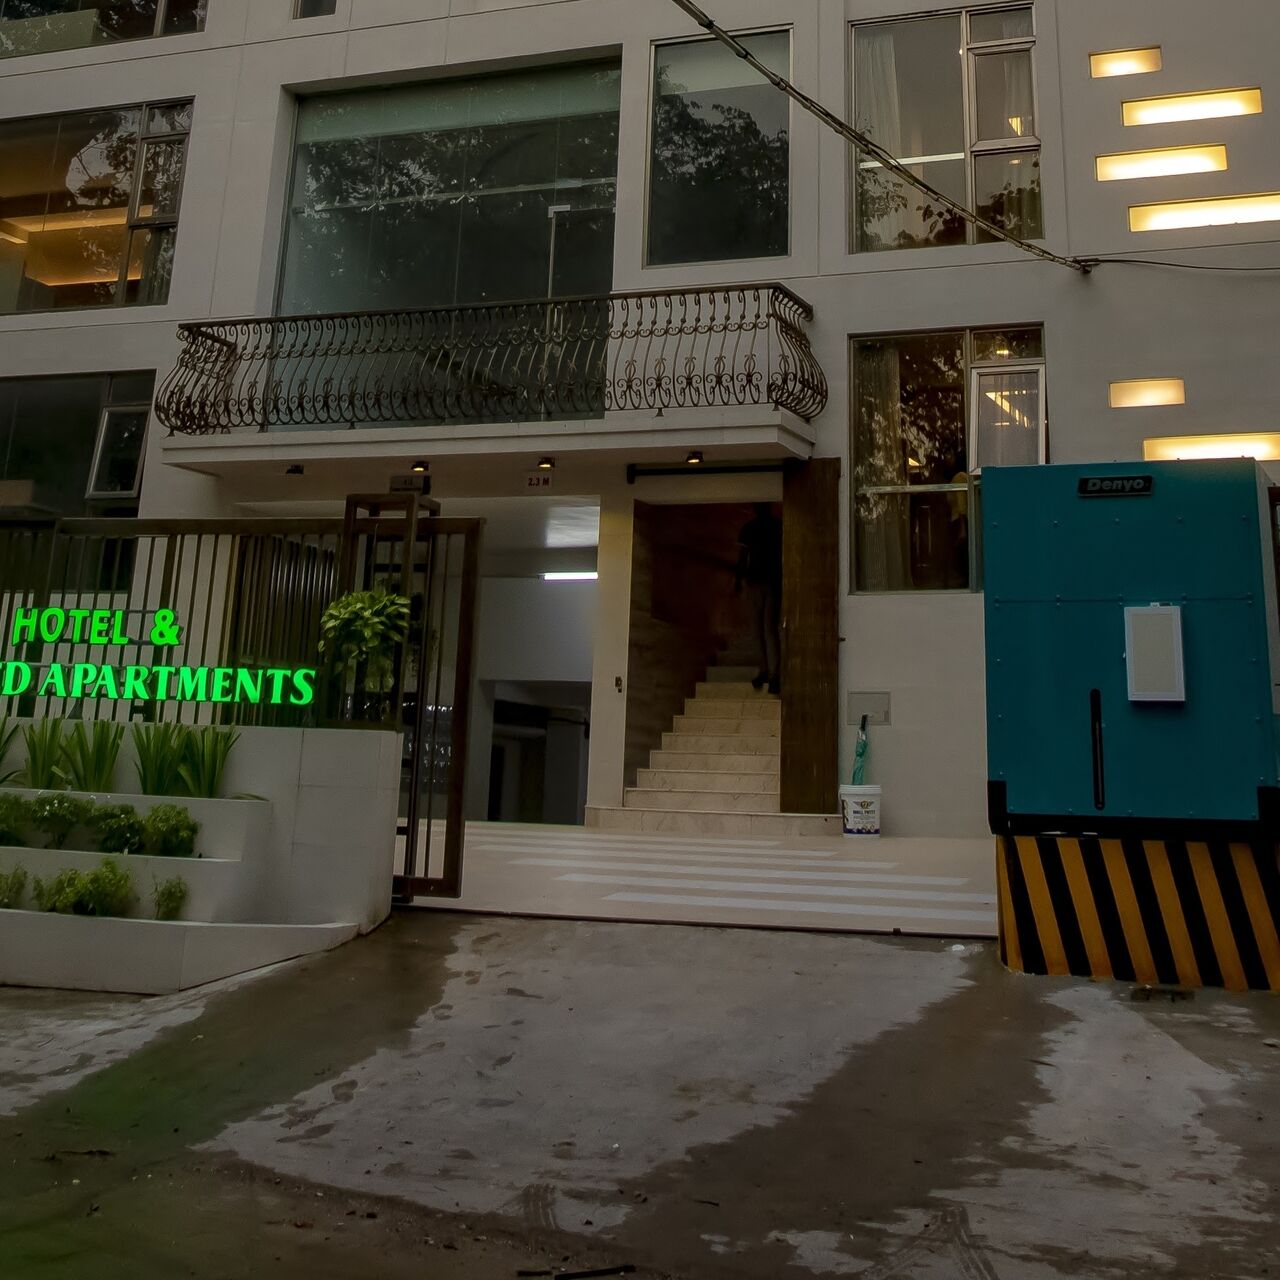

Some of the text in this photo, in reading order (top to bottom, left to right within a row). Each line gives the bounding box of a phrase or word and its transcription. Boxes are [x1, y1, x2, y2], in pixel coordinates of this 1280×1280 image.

[528, 477, 550, 487] 2.3 M
[1087, 479, 1145, 492] Denyo
[12, 607, 182, 646] HOTEL &
[38, 663, 316, 705] APARTMENTS
